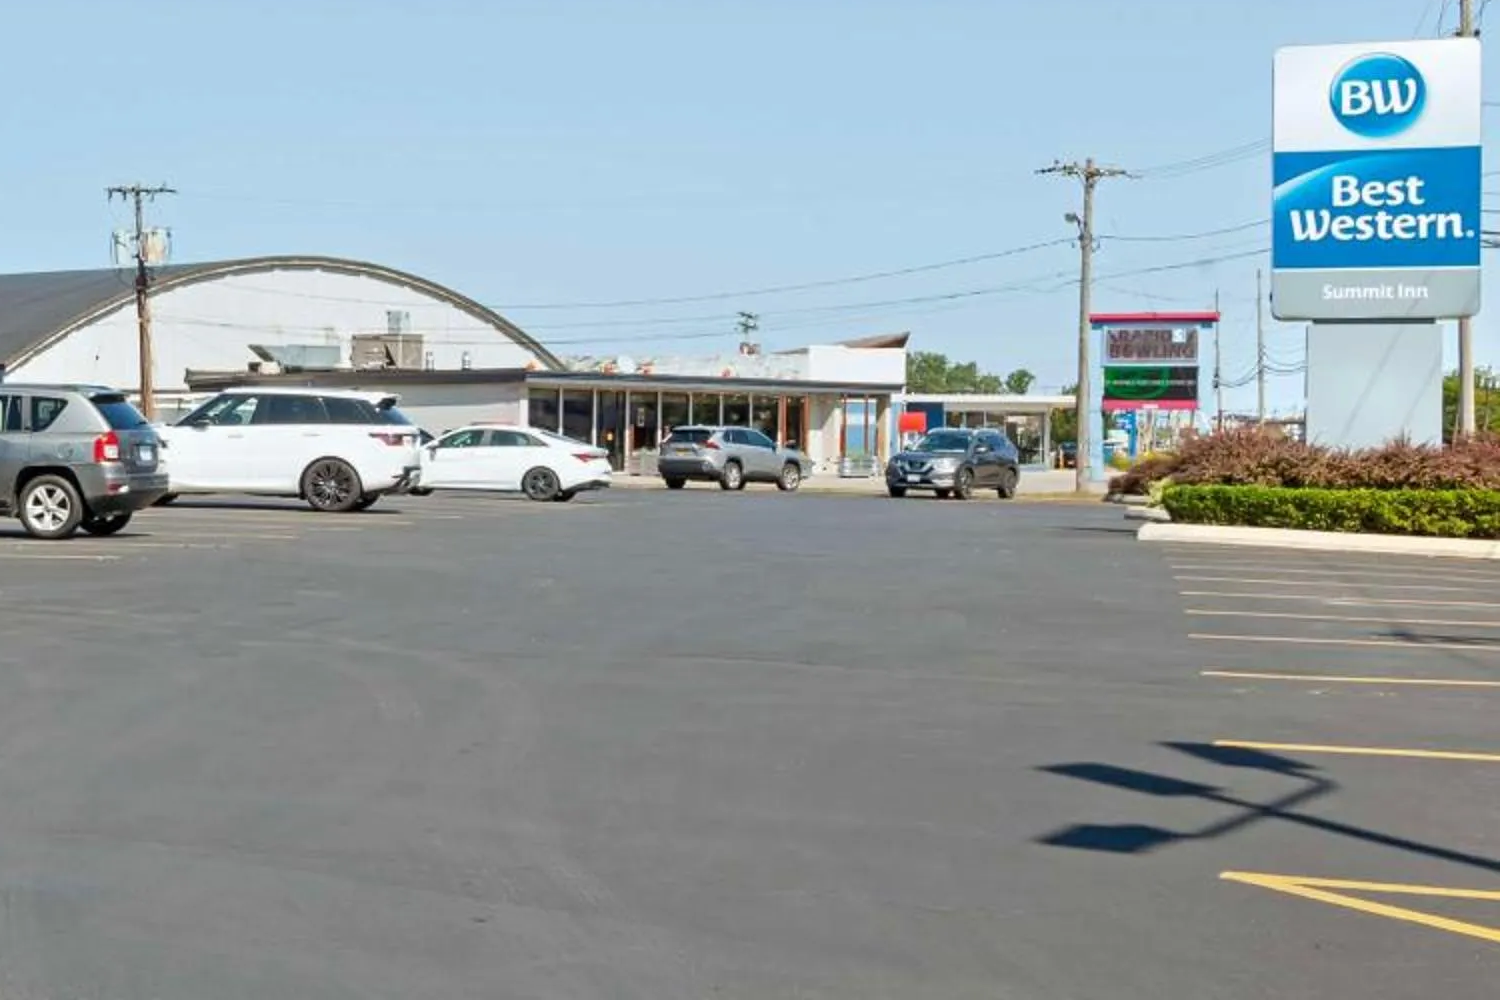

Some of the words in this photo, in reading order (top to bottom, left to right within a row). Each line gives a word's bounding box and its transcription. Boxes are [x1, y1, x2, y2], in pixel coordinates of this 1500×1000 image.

[1340, 78, 1417, 116] BW
[1331, 175, 1426, 207] Best
[1322, 283, 1395, 300] Summit
[1398, 282, 1429, 299] Inn
